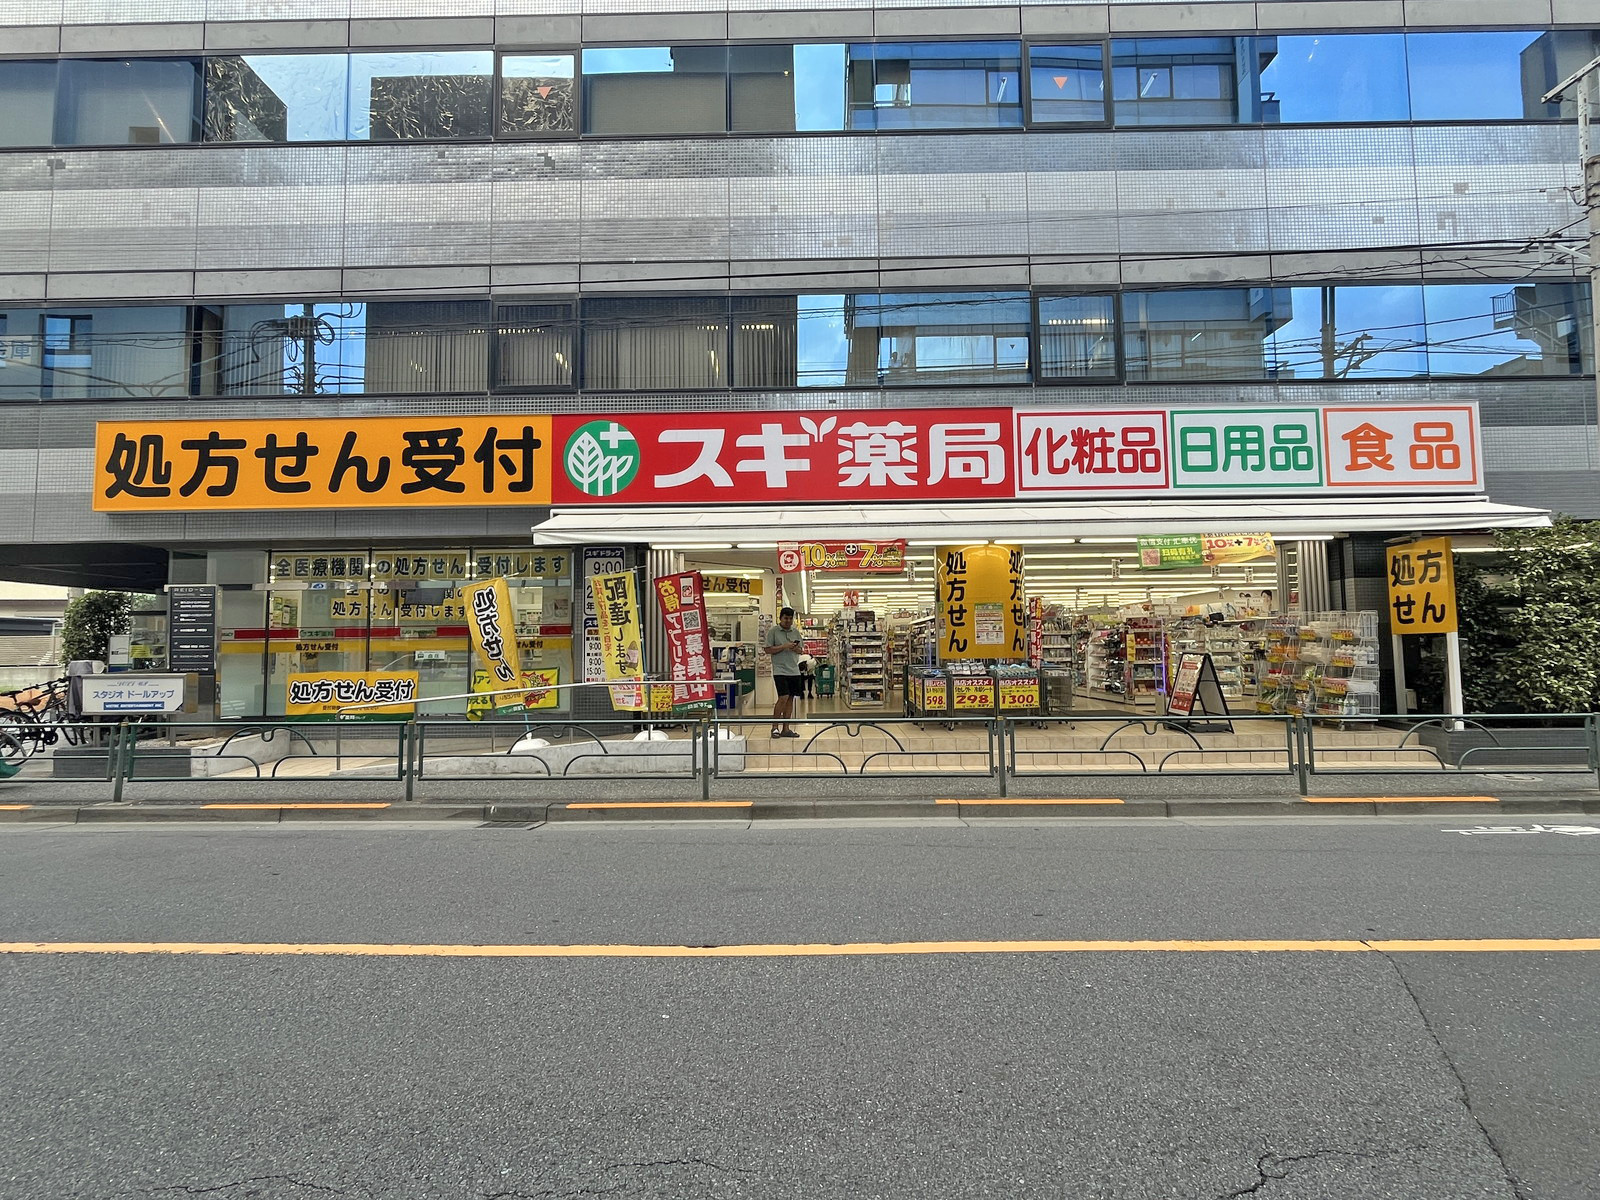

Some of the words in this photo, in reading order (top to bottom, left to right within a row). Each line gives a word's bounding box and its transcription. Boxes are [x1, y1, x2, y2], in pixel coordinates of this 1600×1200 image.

[105, 426, 542, 499] 処方せん受付
[653, 416, 1006, 489] スギ薬局
[1024, 426, 1163, 476] 化粧品
[1180, 423, 1314, 473] 日用品
[1341, 421, 1461, 472] 食品
[585, 549, 622, 557] スギドラッグ
[593, 561, 622, 575] 9:00
[1390, 549, 1443, 587] 処方
[946, 551, 968, 653] 処方せん
[1392, 593, 1446, 626] せん
[92, 690, 124, 699] スタジオ
[127, 690, 175, 699] ドールアップ
[289, 678, 415, 704] 処方せん受付
[926, 695, 944, 706] 598
[956, 694, 989, 704] 298
[1001, 694, 1035, 705] 1300
